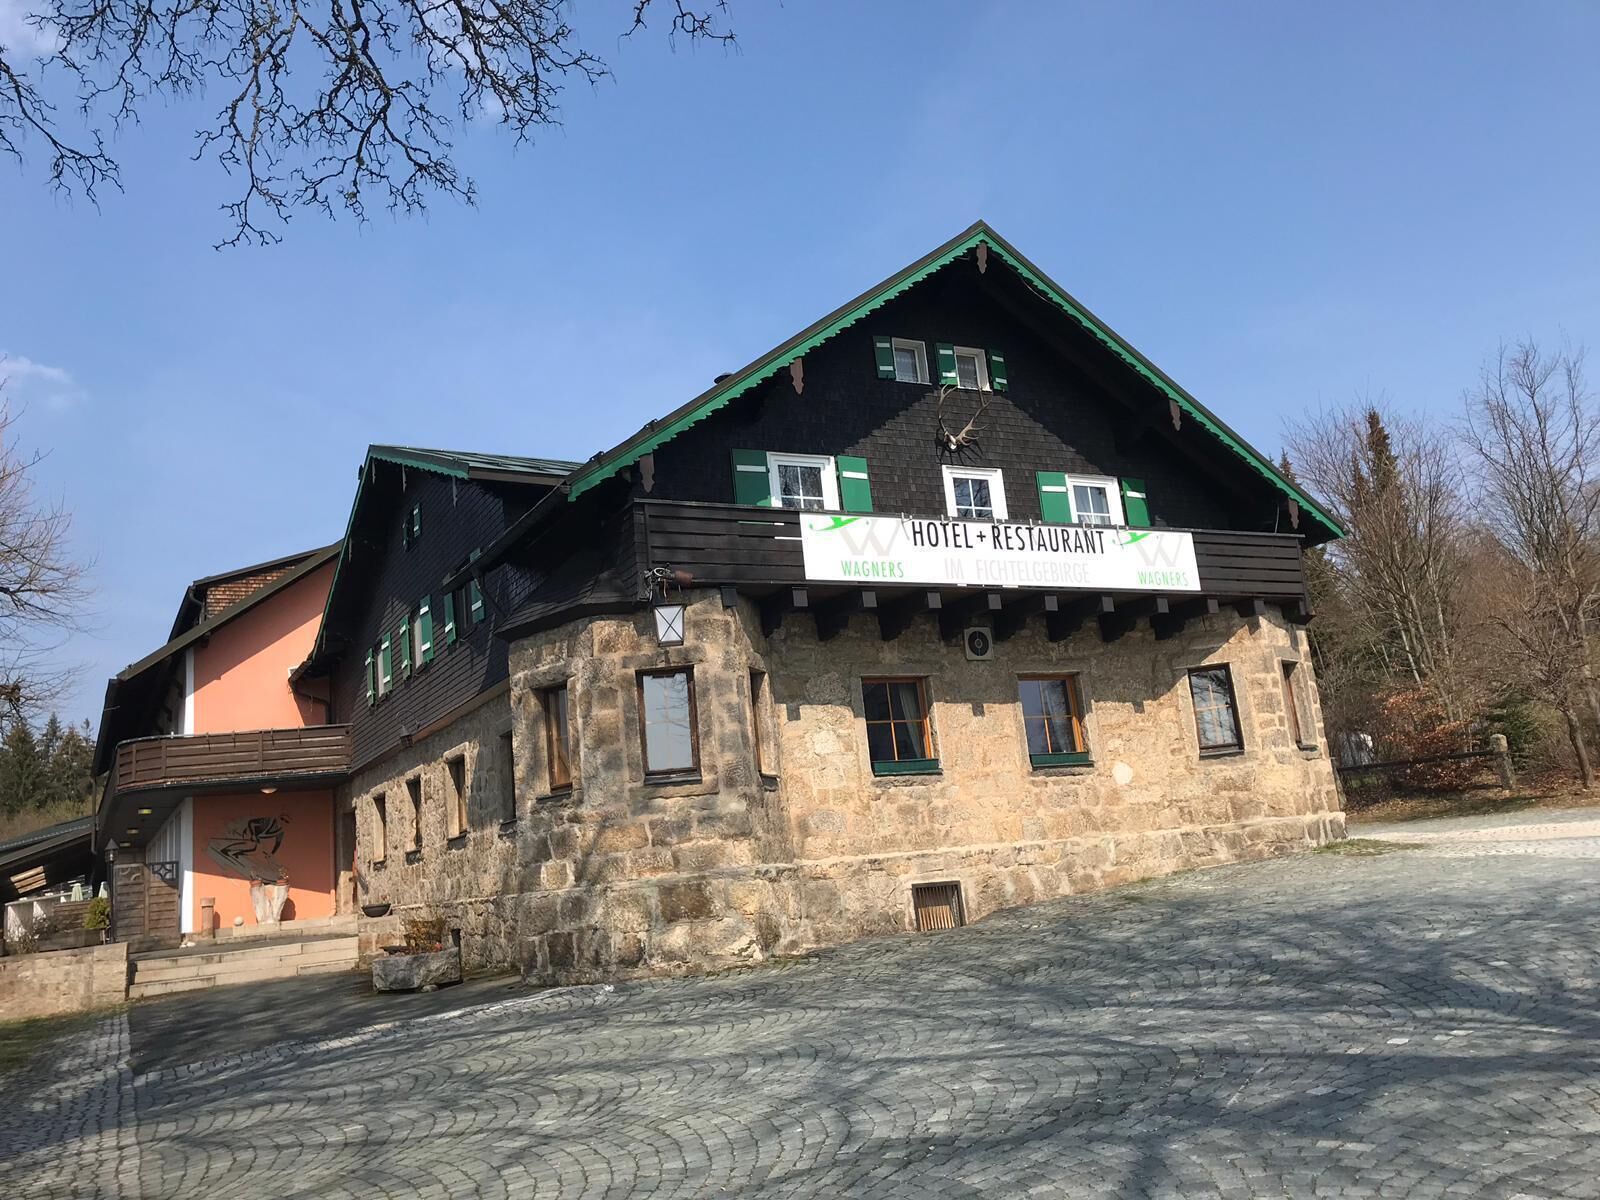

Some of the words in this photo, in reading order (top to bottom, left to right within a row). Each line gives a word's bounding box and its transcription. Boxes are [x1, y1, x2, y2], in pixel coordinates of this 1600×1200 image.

[840, 560, 904, 578] WAGNERS
[944, 558, 963, 580] IM
[976, 559, 1090, 583] FICHTELGEBIRGE
[1138, 570, 1190, 586] WAGNERS
